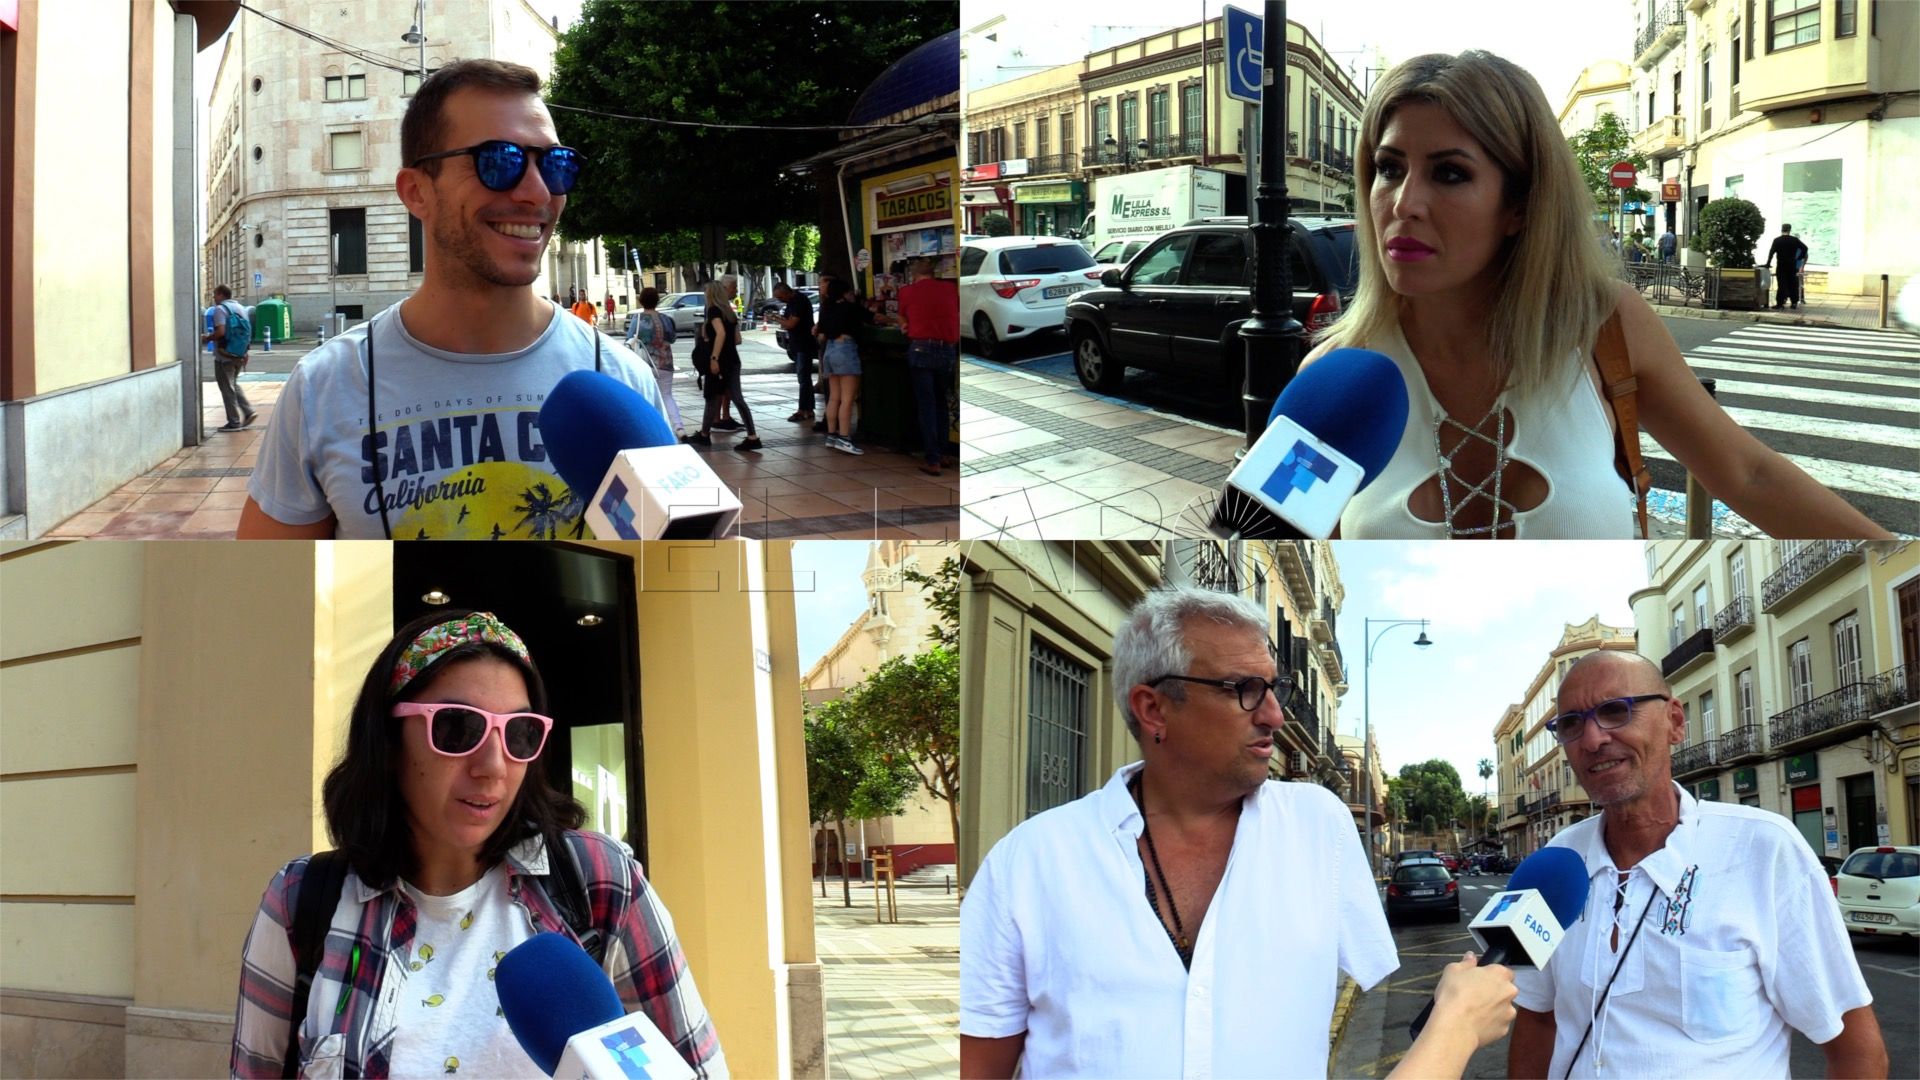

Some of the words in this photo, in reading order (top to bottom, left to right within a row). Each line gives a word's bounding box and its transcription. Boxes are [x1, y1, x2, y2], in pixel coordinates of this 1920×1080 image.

[880, 190, 945, 218] TABACOS
[1155, 224, 1176, 232] MELILLA
[358, 413, 383, 425] TE
[395, 404, 422, 417] DOG
[434, 398, 473, 409] DAYS
[486, 395, 503, 404] OF
[516, 394, 544, 402] SUM
[361, 412, 505, 484] SANTA
[363, 471, 487, 515] California
[657, 465, 701, 495] FARO
[1524, 913, 1551, 943] FARO
